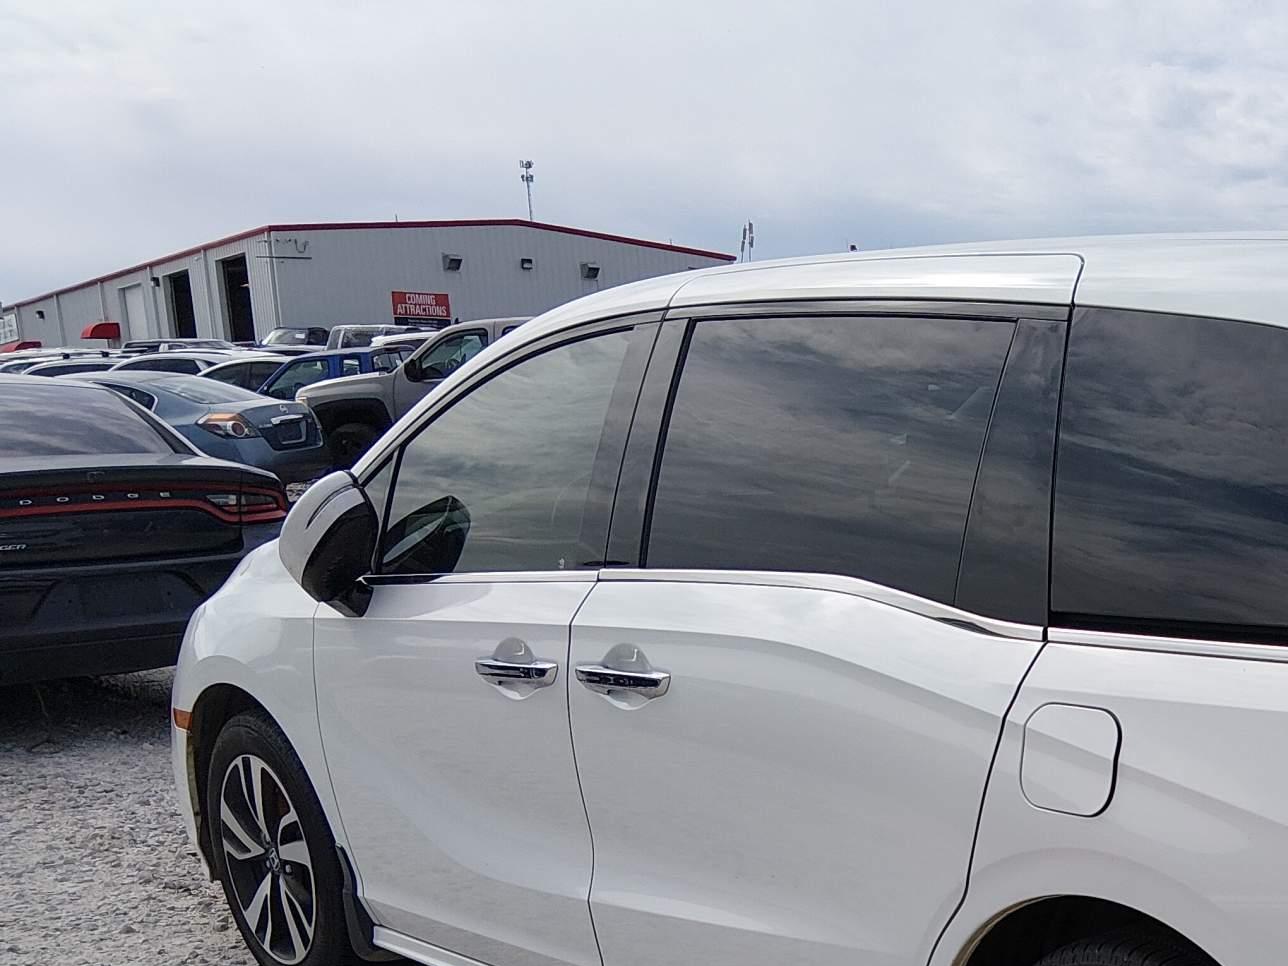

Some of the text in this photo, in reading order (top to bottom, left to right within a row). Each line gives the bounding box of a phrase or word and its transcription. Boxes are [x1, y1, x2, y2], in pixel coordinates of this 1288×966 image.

[405, 293, 436, 305] COMING
[397, 303, 447, 316] ATTRACTIONS
[19, 491, 170, 506] DODGE
